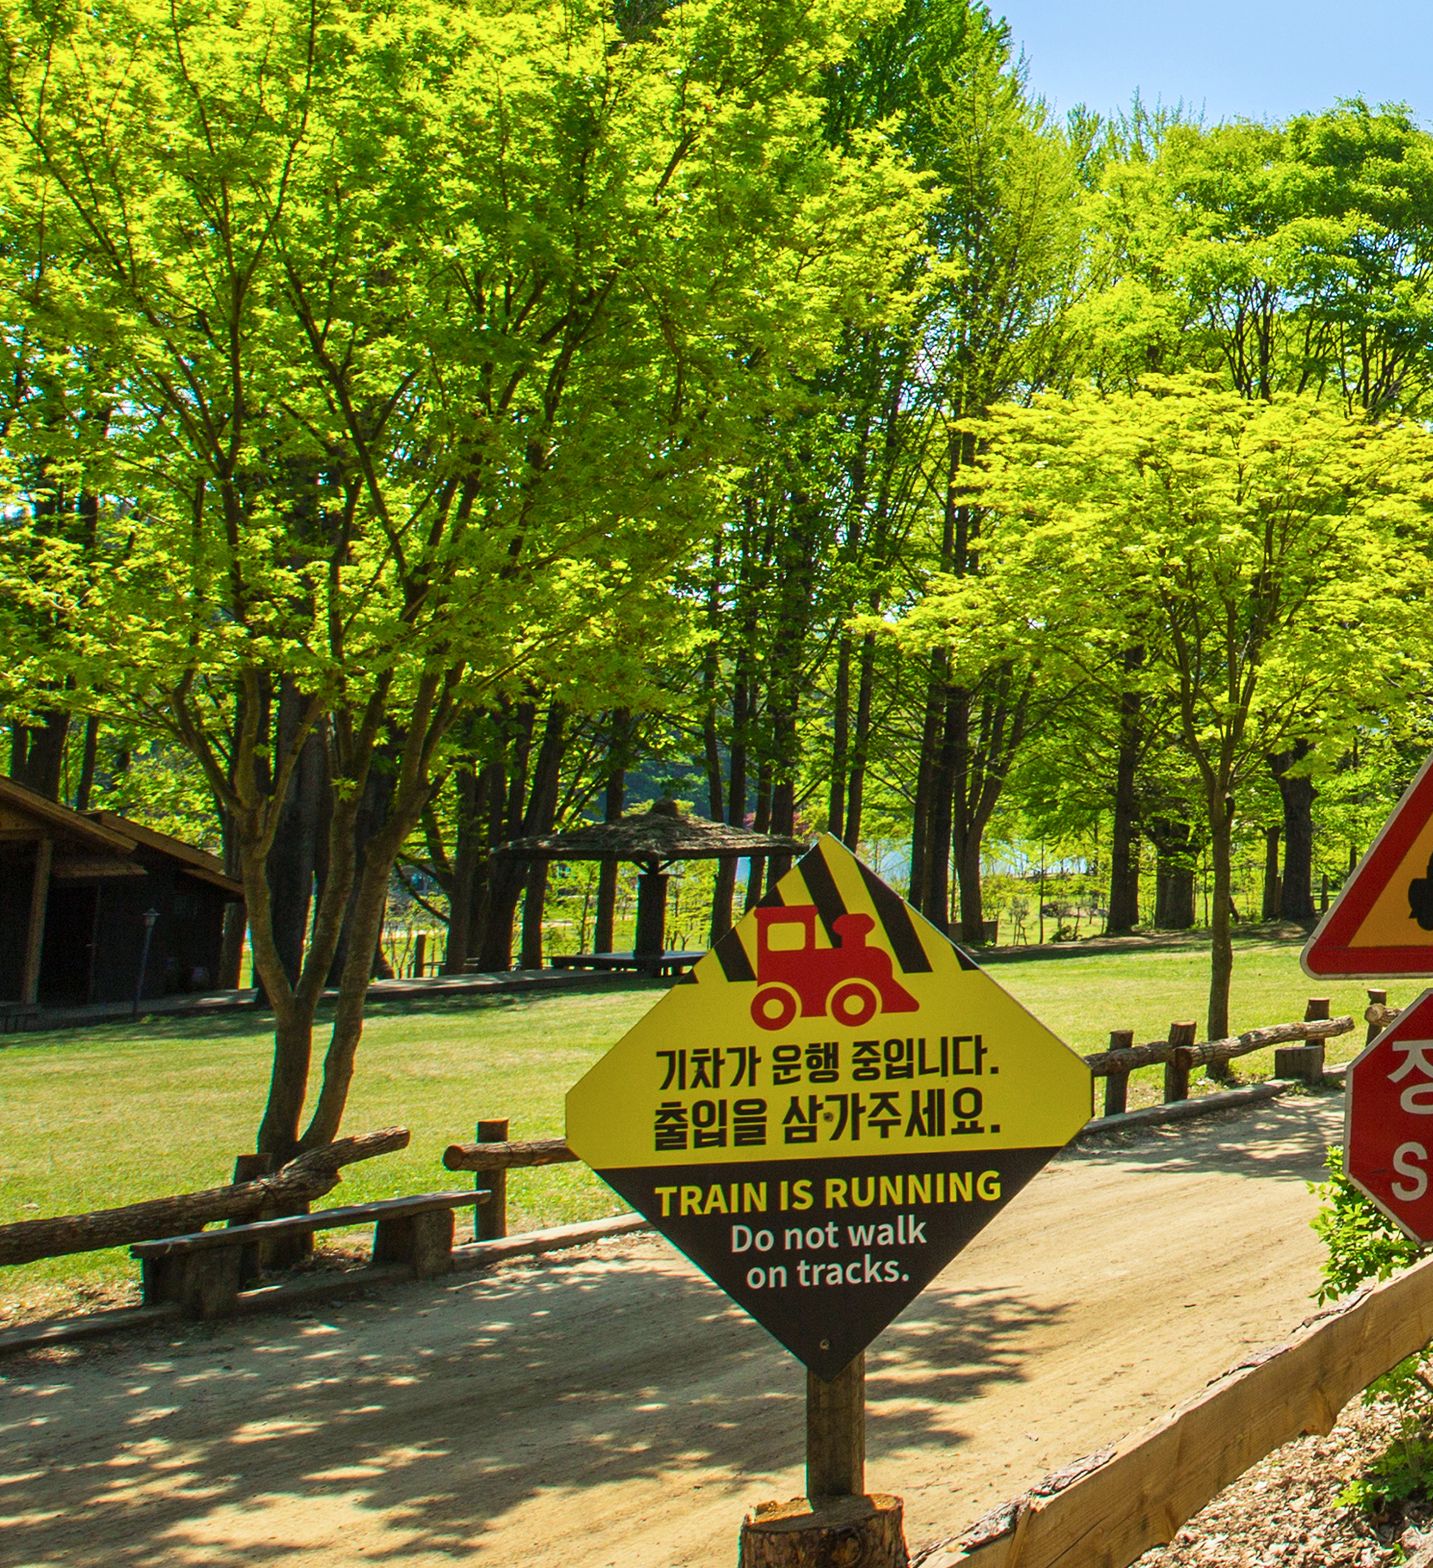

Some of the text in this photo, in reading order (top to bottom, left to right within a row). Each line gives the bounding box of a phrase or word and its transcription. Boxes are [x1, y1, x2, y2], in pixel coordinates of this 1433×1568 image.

[656, 1034, 1000, 1090] 기차가 운행 중입니다.
[653, 1086, 1001, 1152] 출입을 삼가주세요.
[654, 1170, 1002, 1217] TRAIN IS RUNNING
[731, 1215, 928, 1253] Do not walk
[746, 1252, 910, 1290] on tracks.
